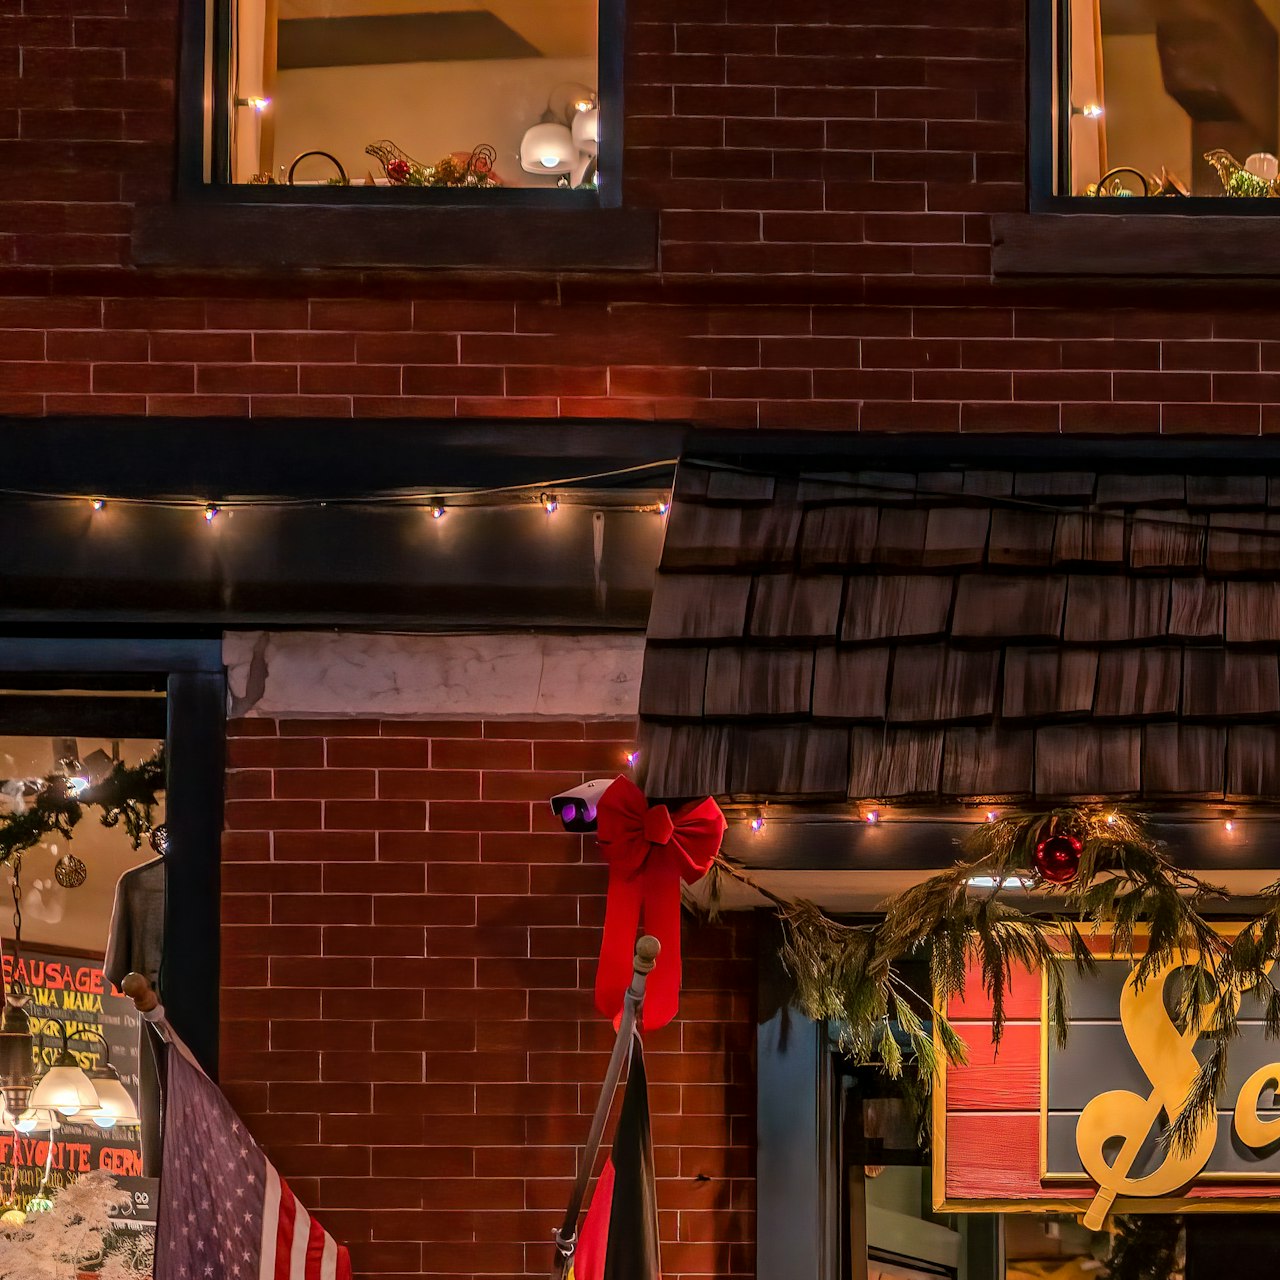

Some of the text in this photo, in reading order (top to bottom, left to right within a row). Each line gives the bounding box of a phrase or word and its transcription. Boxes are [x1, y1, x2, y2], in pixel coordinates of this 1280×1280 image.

[3, 956, 104, 994] SAUSAGE
[62, 990, 104, 1015] MAMA
[0, 1136, 91, 1172] FAVORITE
